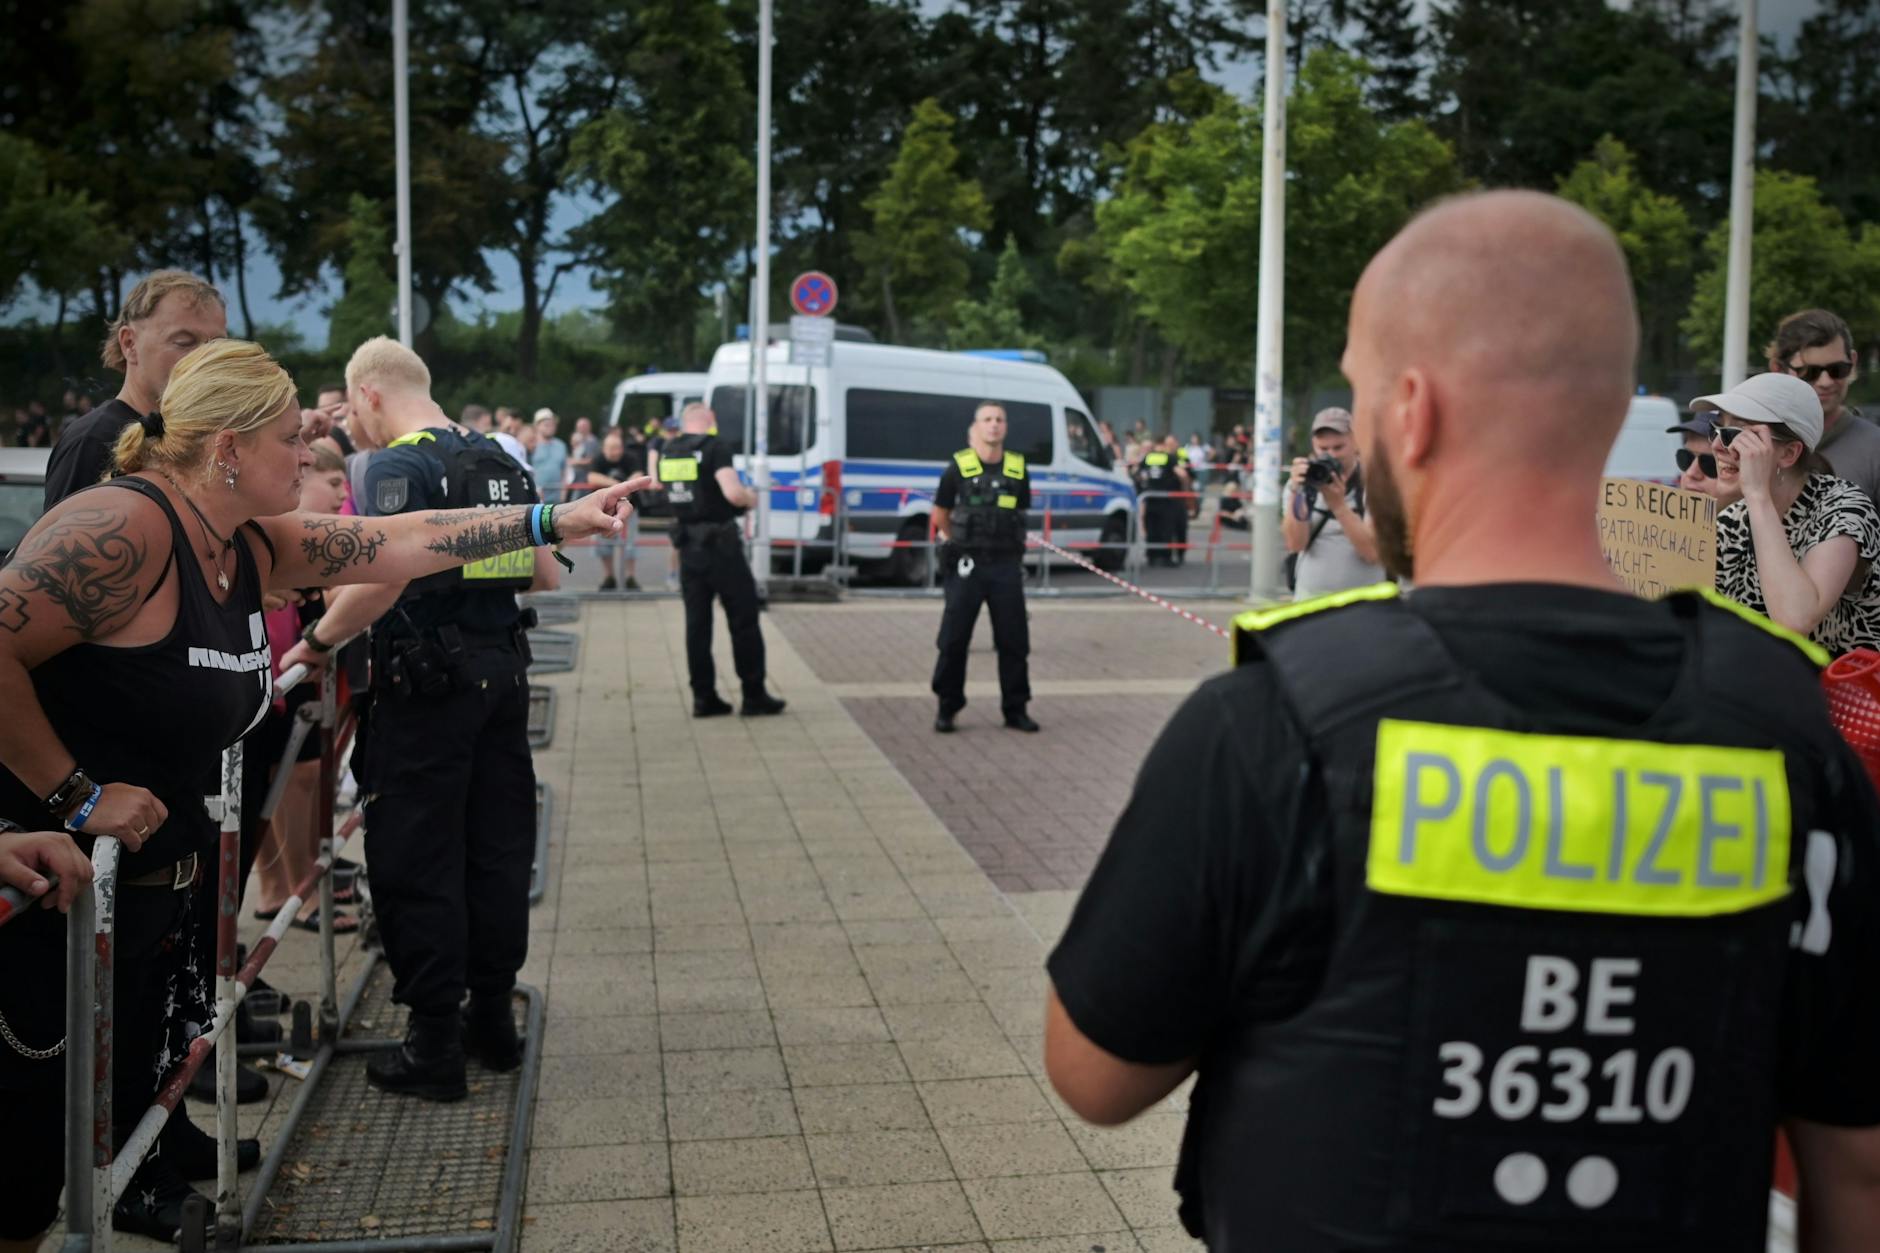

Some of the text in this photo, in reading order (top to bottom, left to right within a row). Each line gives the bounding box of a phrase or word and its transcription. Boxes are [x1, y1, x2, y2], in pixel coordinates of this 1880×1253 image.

[487, 479, 511, 501] BE
[1605, 482, 1715, 532] ES REICHT!!!
[1600, 517, 1707, 562] PATRIARCHALE
[1398, 750, 1770, 890] POLIZEI
[1519, 954, 1642, 1035] BE
[1432, 1040, 1696, 1123] 36310
